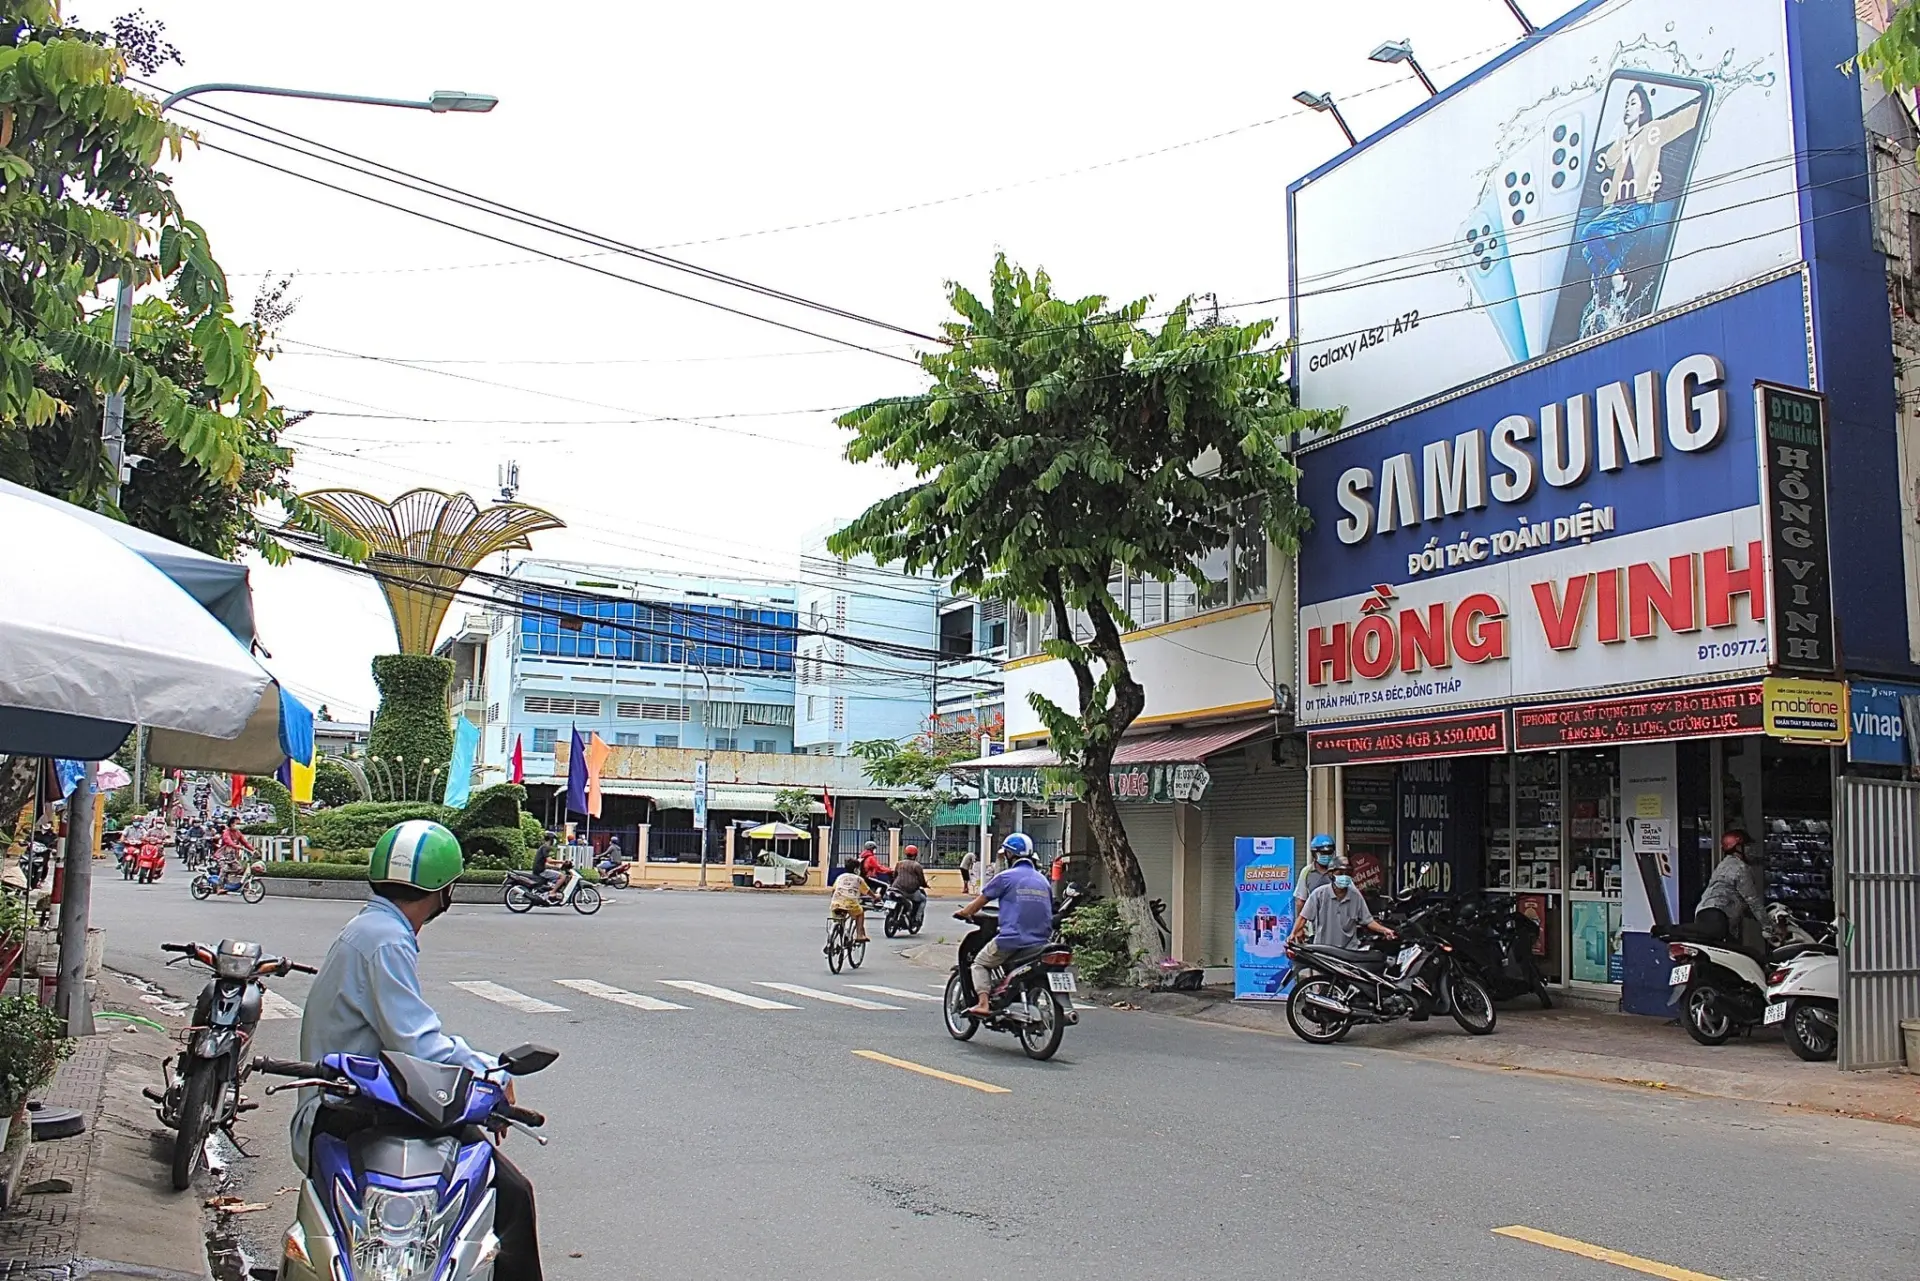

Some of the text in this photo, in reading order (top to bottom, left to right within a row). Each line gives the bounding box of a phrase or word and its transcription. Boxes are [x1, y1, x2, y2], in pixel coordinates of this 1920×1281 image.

[1308, 310, 1420, 372] Galaxy A52 A72
[1771, 396, 1814, 425] ĐTDĐ
[1336, 353, 1727, 545] SAMSUNG
[1407, 502, 1615, 577] ĐỐI TÁC TOÀN DIỆN
[1305, 540, 1765, 687] HỒNG VINH
[1781, 558, 1821, 660] VINH
[1305, 702, 1315, 711] 01
[1435, 678, 1462, 695] THÁP
[1771, 696, 1839, 715] mobifone
[1521, 711, 1558, 727] IPHONE
[1559, 709, 1581, 724] QUA
[1375, 733, 1404, 750] A03S
[1405, 731, 1431, 748] 4GB
[993, 776, 1019, 794] RAU
[1020, 770, 1040, 794] MÁ
[1119, 767, 1150, 797] ĐÉC
[1419, 794, 1450, 819] MODEL
[1410, 821, 1443, 855] GIÁ CHỈ
[1265, 870, 1287, 879] SALE
[1443, 861, 1452, 892] Đ
